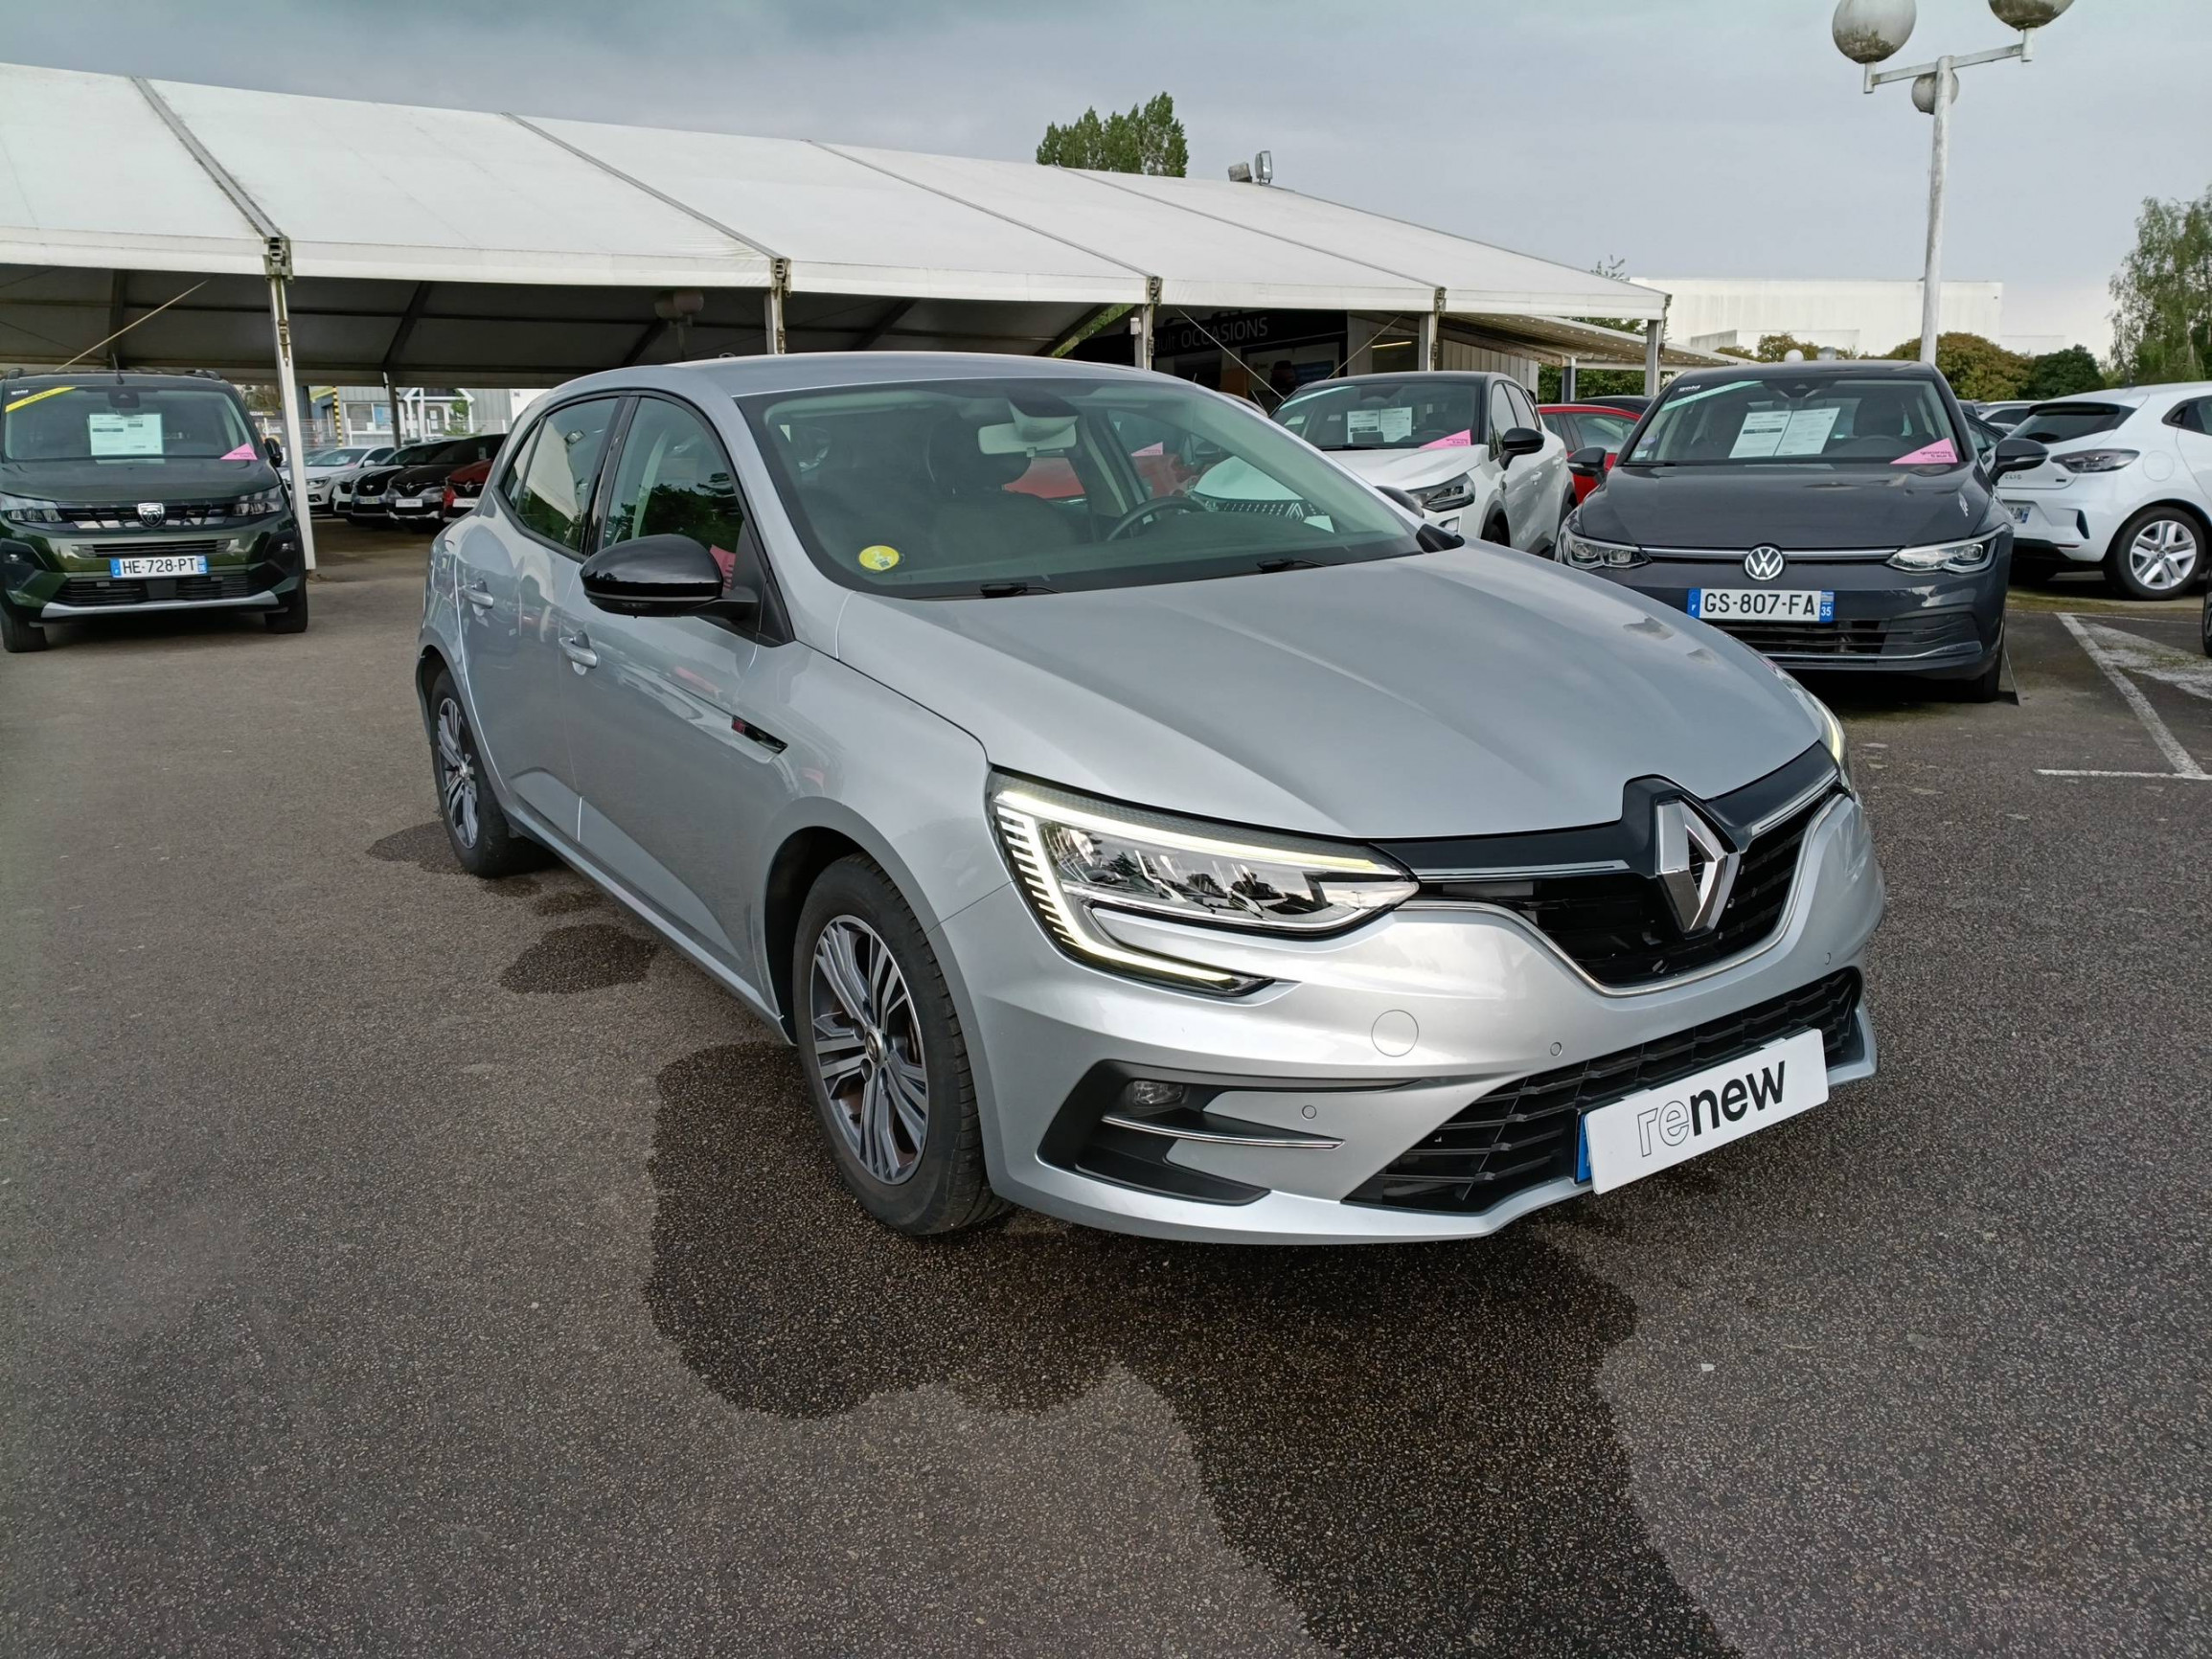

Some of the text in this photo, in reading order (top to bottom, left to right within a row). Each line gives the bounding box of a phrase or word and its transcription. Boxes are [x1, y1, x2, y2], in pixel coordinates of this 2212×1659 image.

[1180, 317, 1269, 348] OCCASIONS
[122, 558, 195, 574] HE-728-PT
[1704, 592, 1815, 616] GS-807-FA
[1820, 606, 1832, 617] 35
[1636, 1059, 1786, 1158] renew
